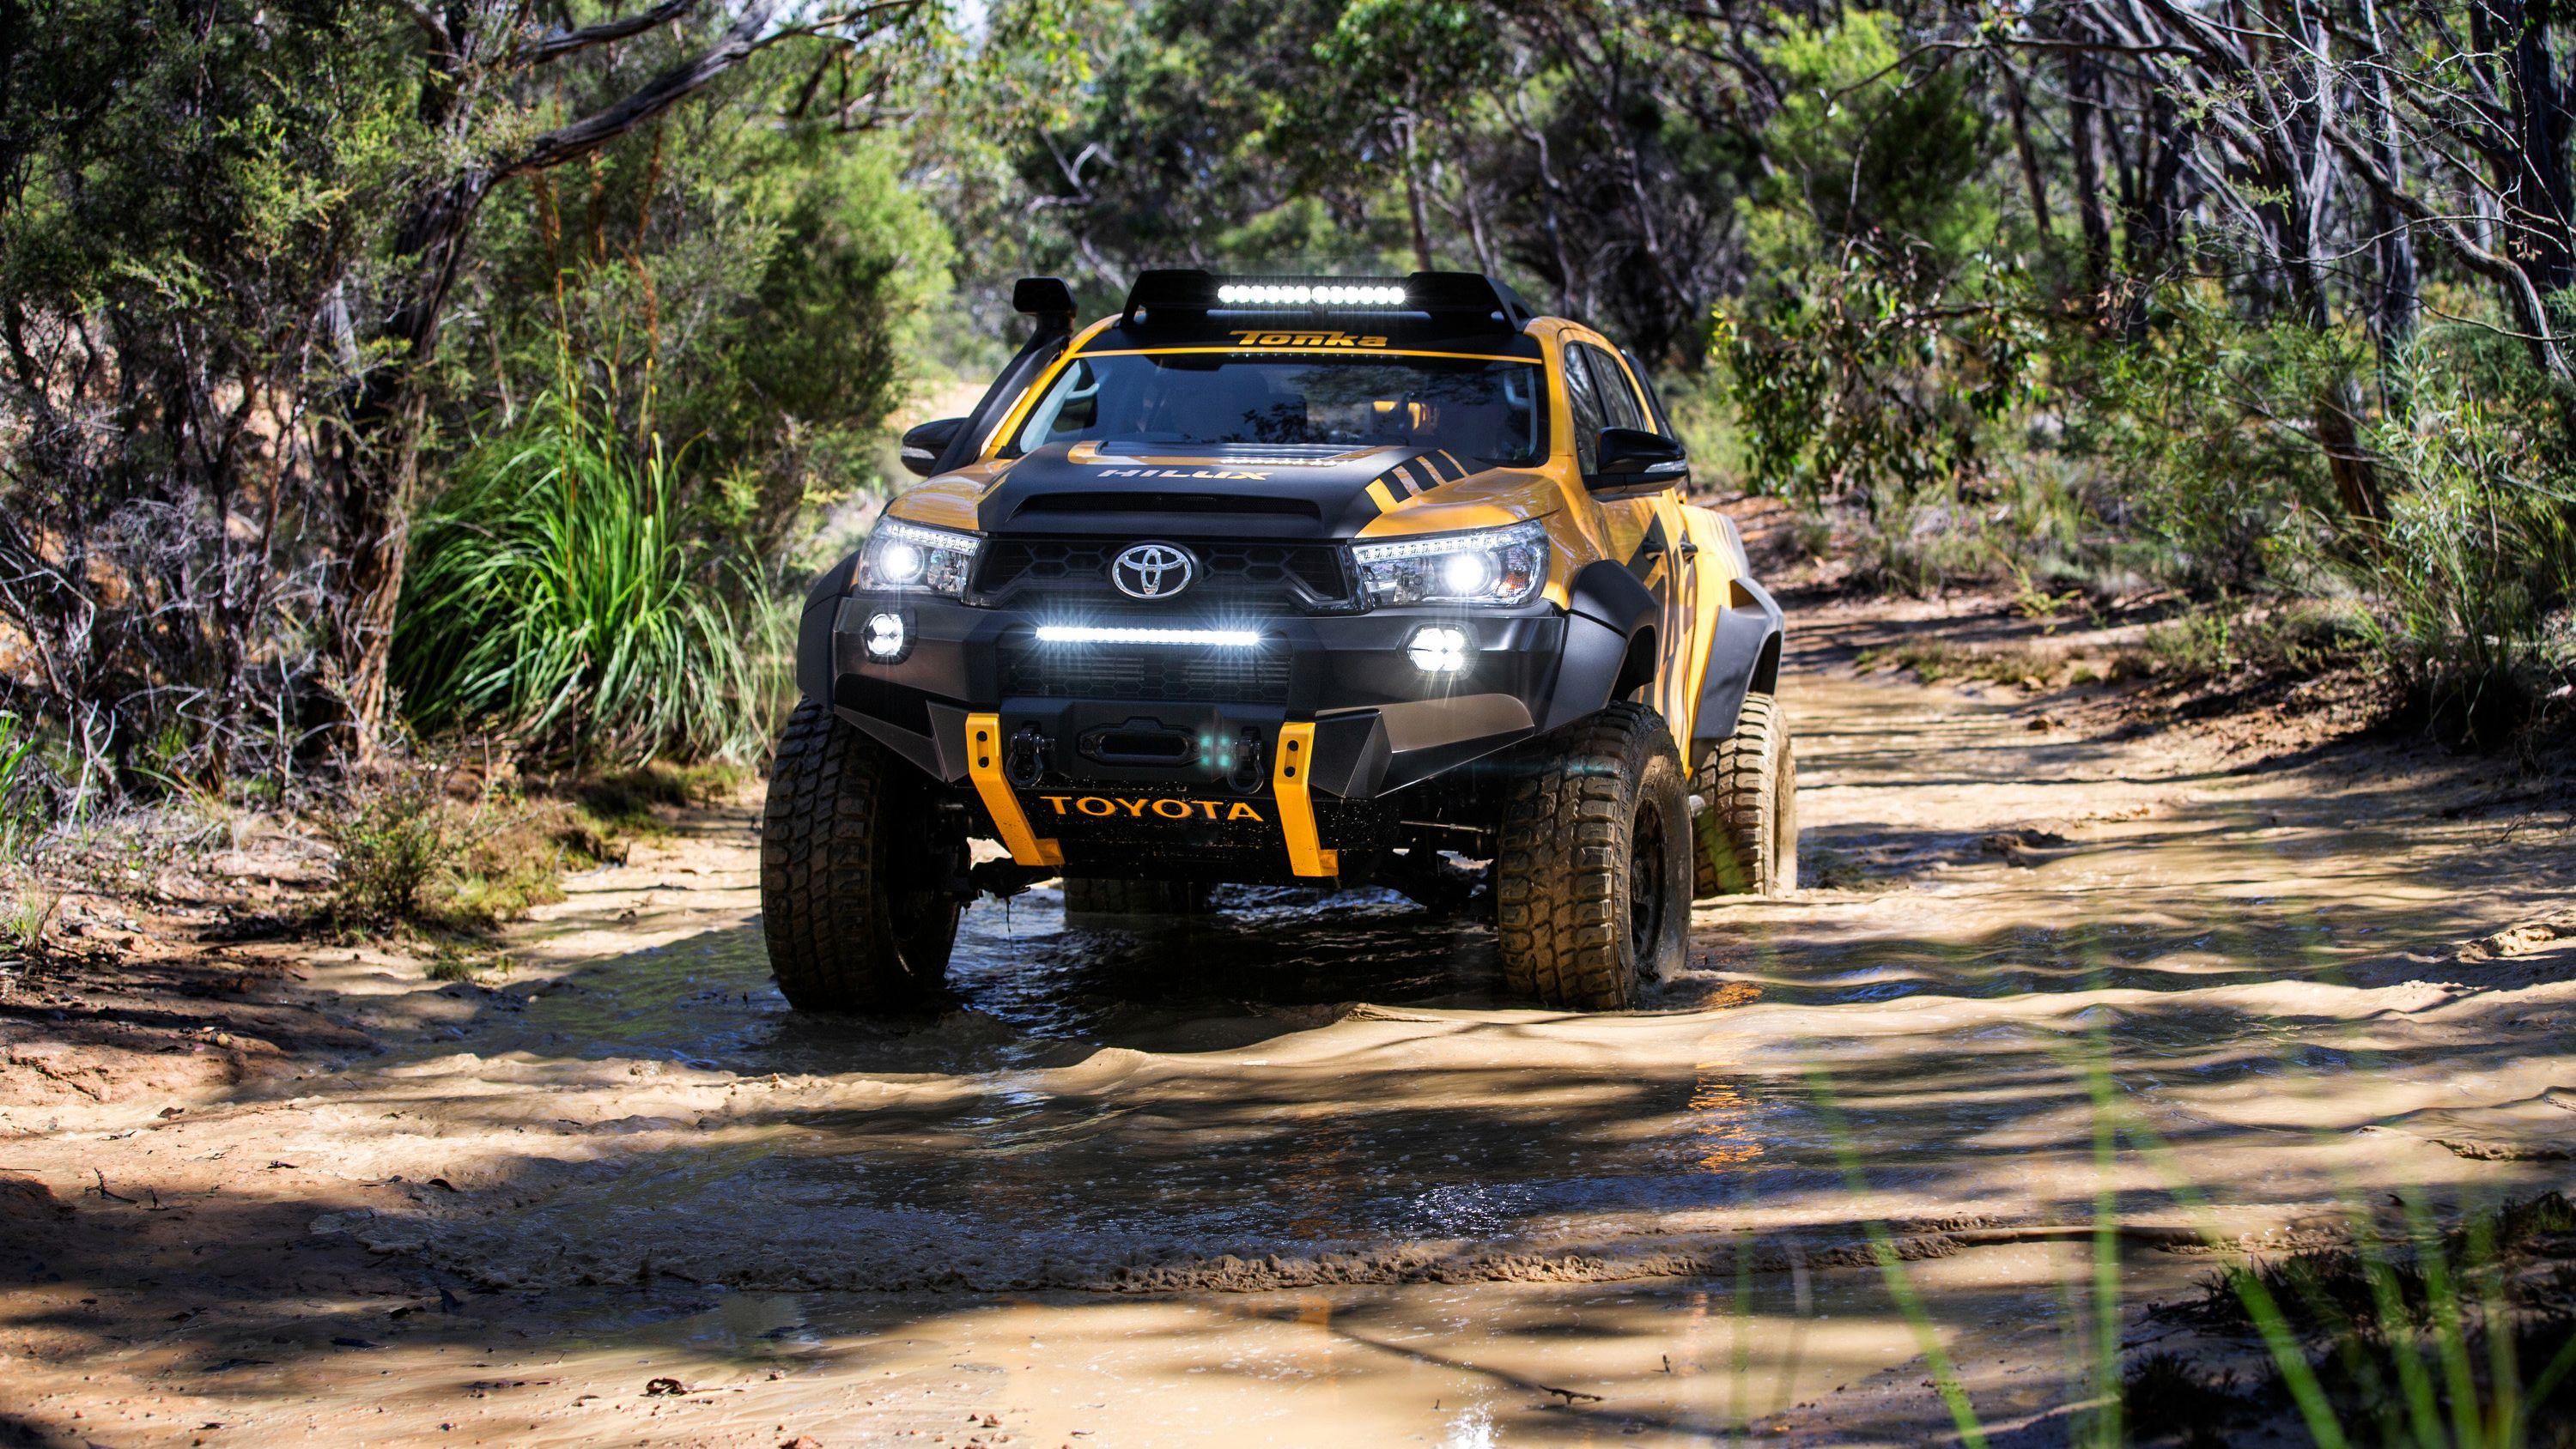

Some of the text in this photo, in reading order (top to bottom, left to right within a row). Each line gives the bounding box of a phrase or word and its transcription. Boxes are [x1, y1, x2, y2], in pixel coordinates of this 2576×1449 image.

[1230, 330, 1388, 347] Tonka
[1097, 470, 1273, 481] HILUX
[1039, 796, 1264, 822] TOYOTA
